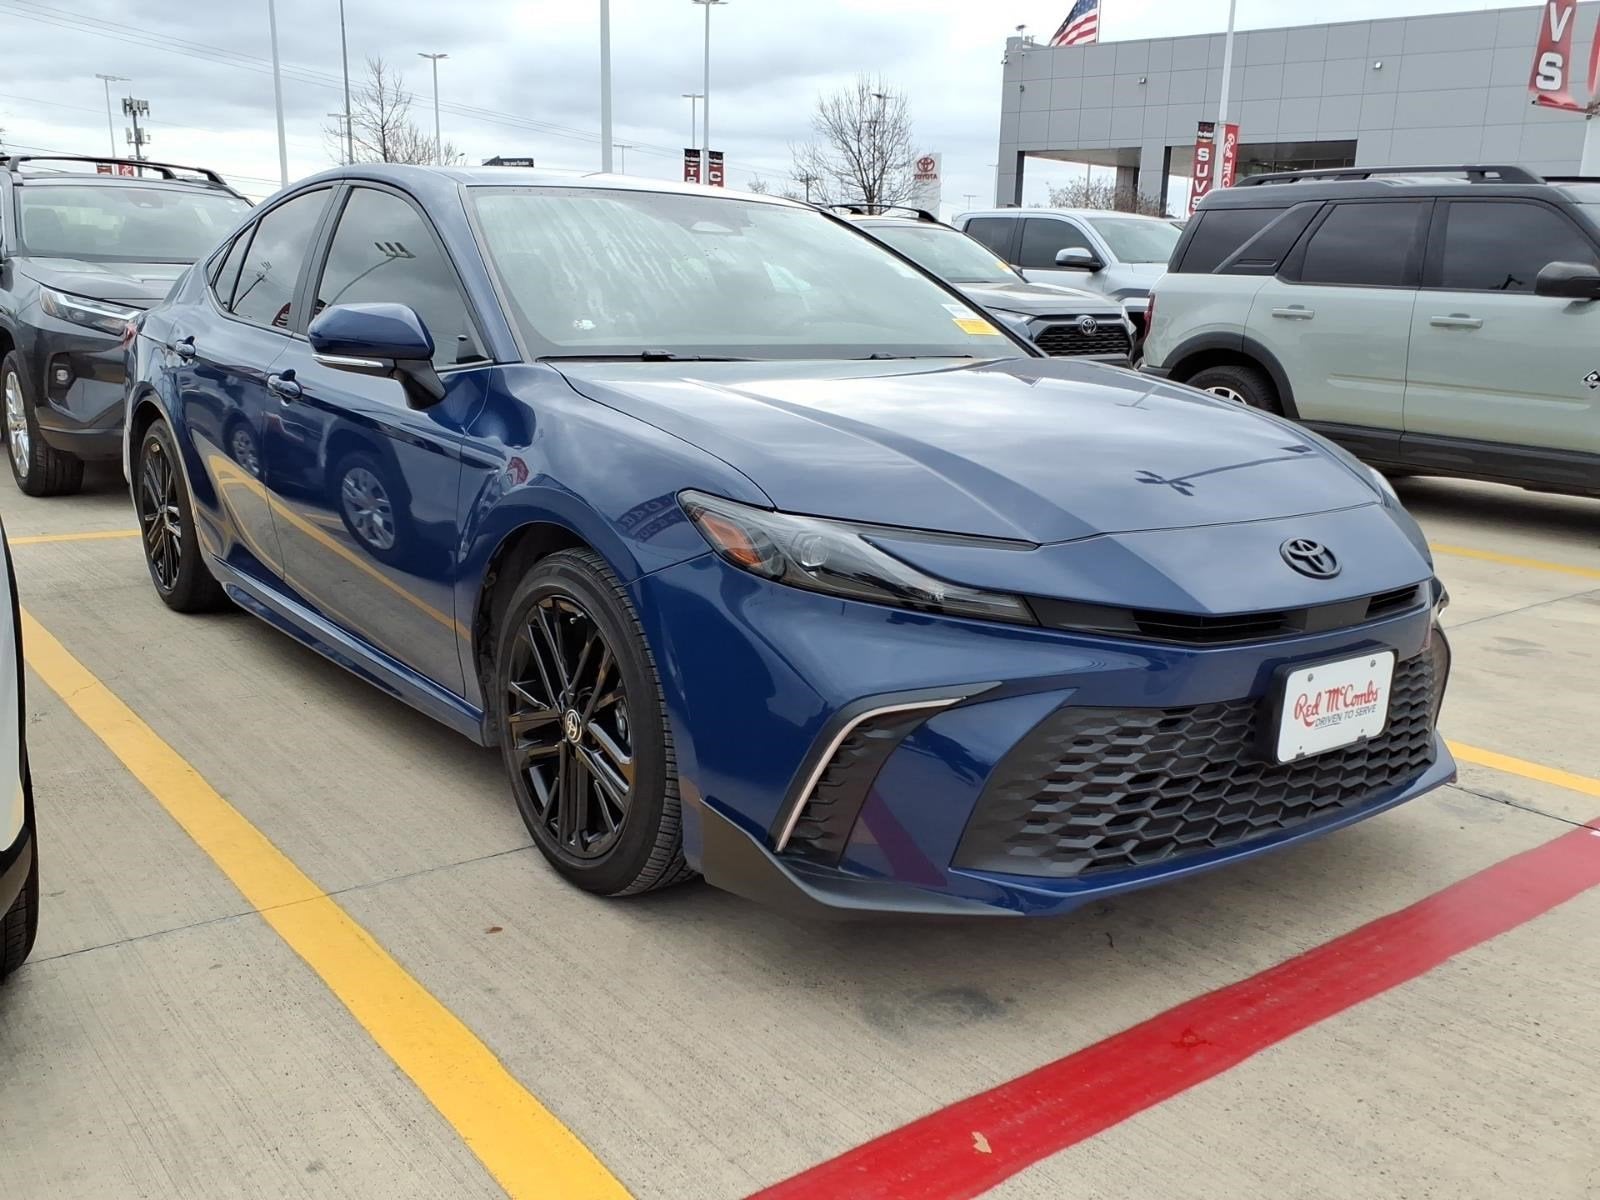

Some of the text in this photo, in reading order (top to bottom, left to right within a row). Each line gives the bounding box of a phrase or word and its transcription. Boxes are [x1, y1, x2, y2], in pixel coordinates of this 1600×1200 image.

[1294, 692, 1322, 727] Red
[1315, 704, 1377, 727] DRIVEN TO SERVE
